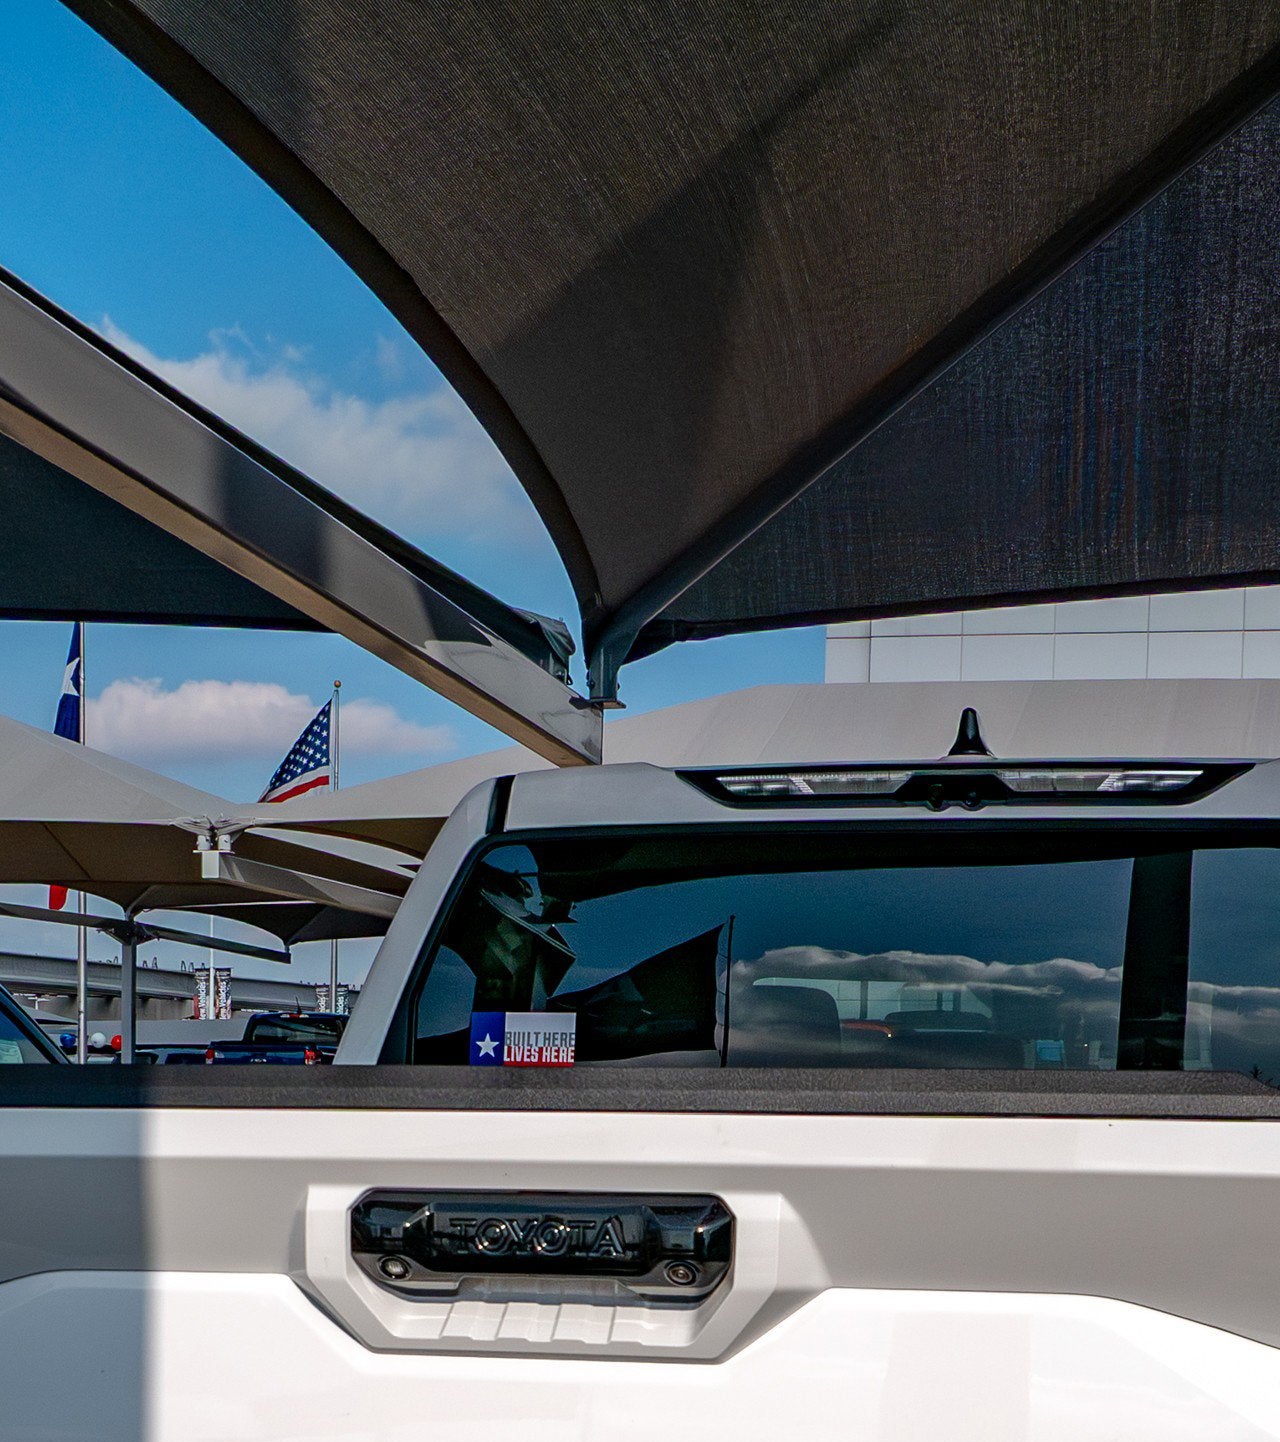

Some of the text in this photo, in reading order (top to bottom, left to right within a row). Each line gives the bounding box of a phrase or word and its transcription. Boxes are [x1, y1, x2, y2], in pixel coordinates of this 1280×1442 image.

[505, 1031, 576, 1047] BUILT HERE
[504, 1046, 575, 1063] LIVES HERE
[449, 1214, 625, 1257] TOYOTA
